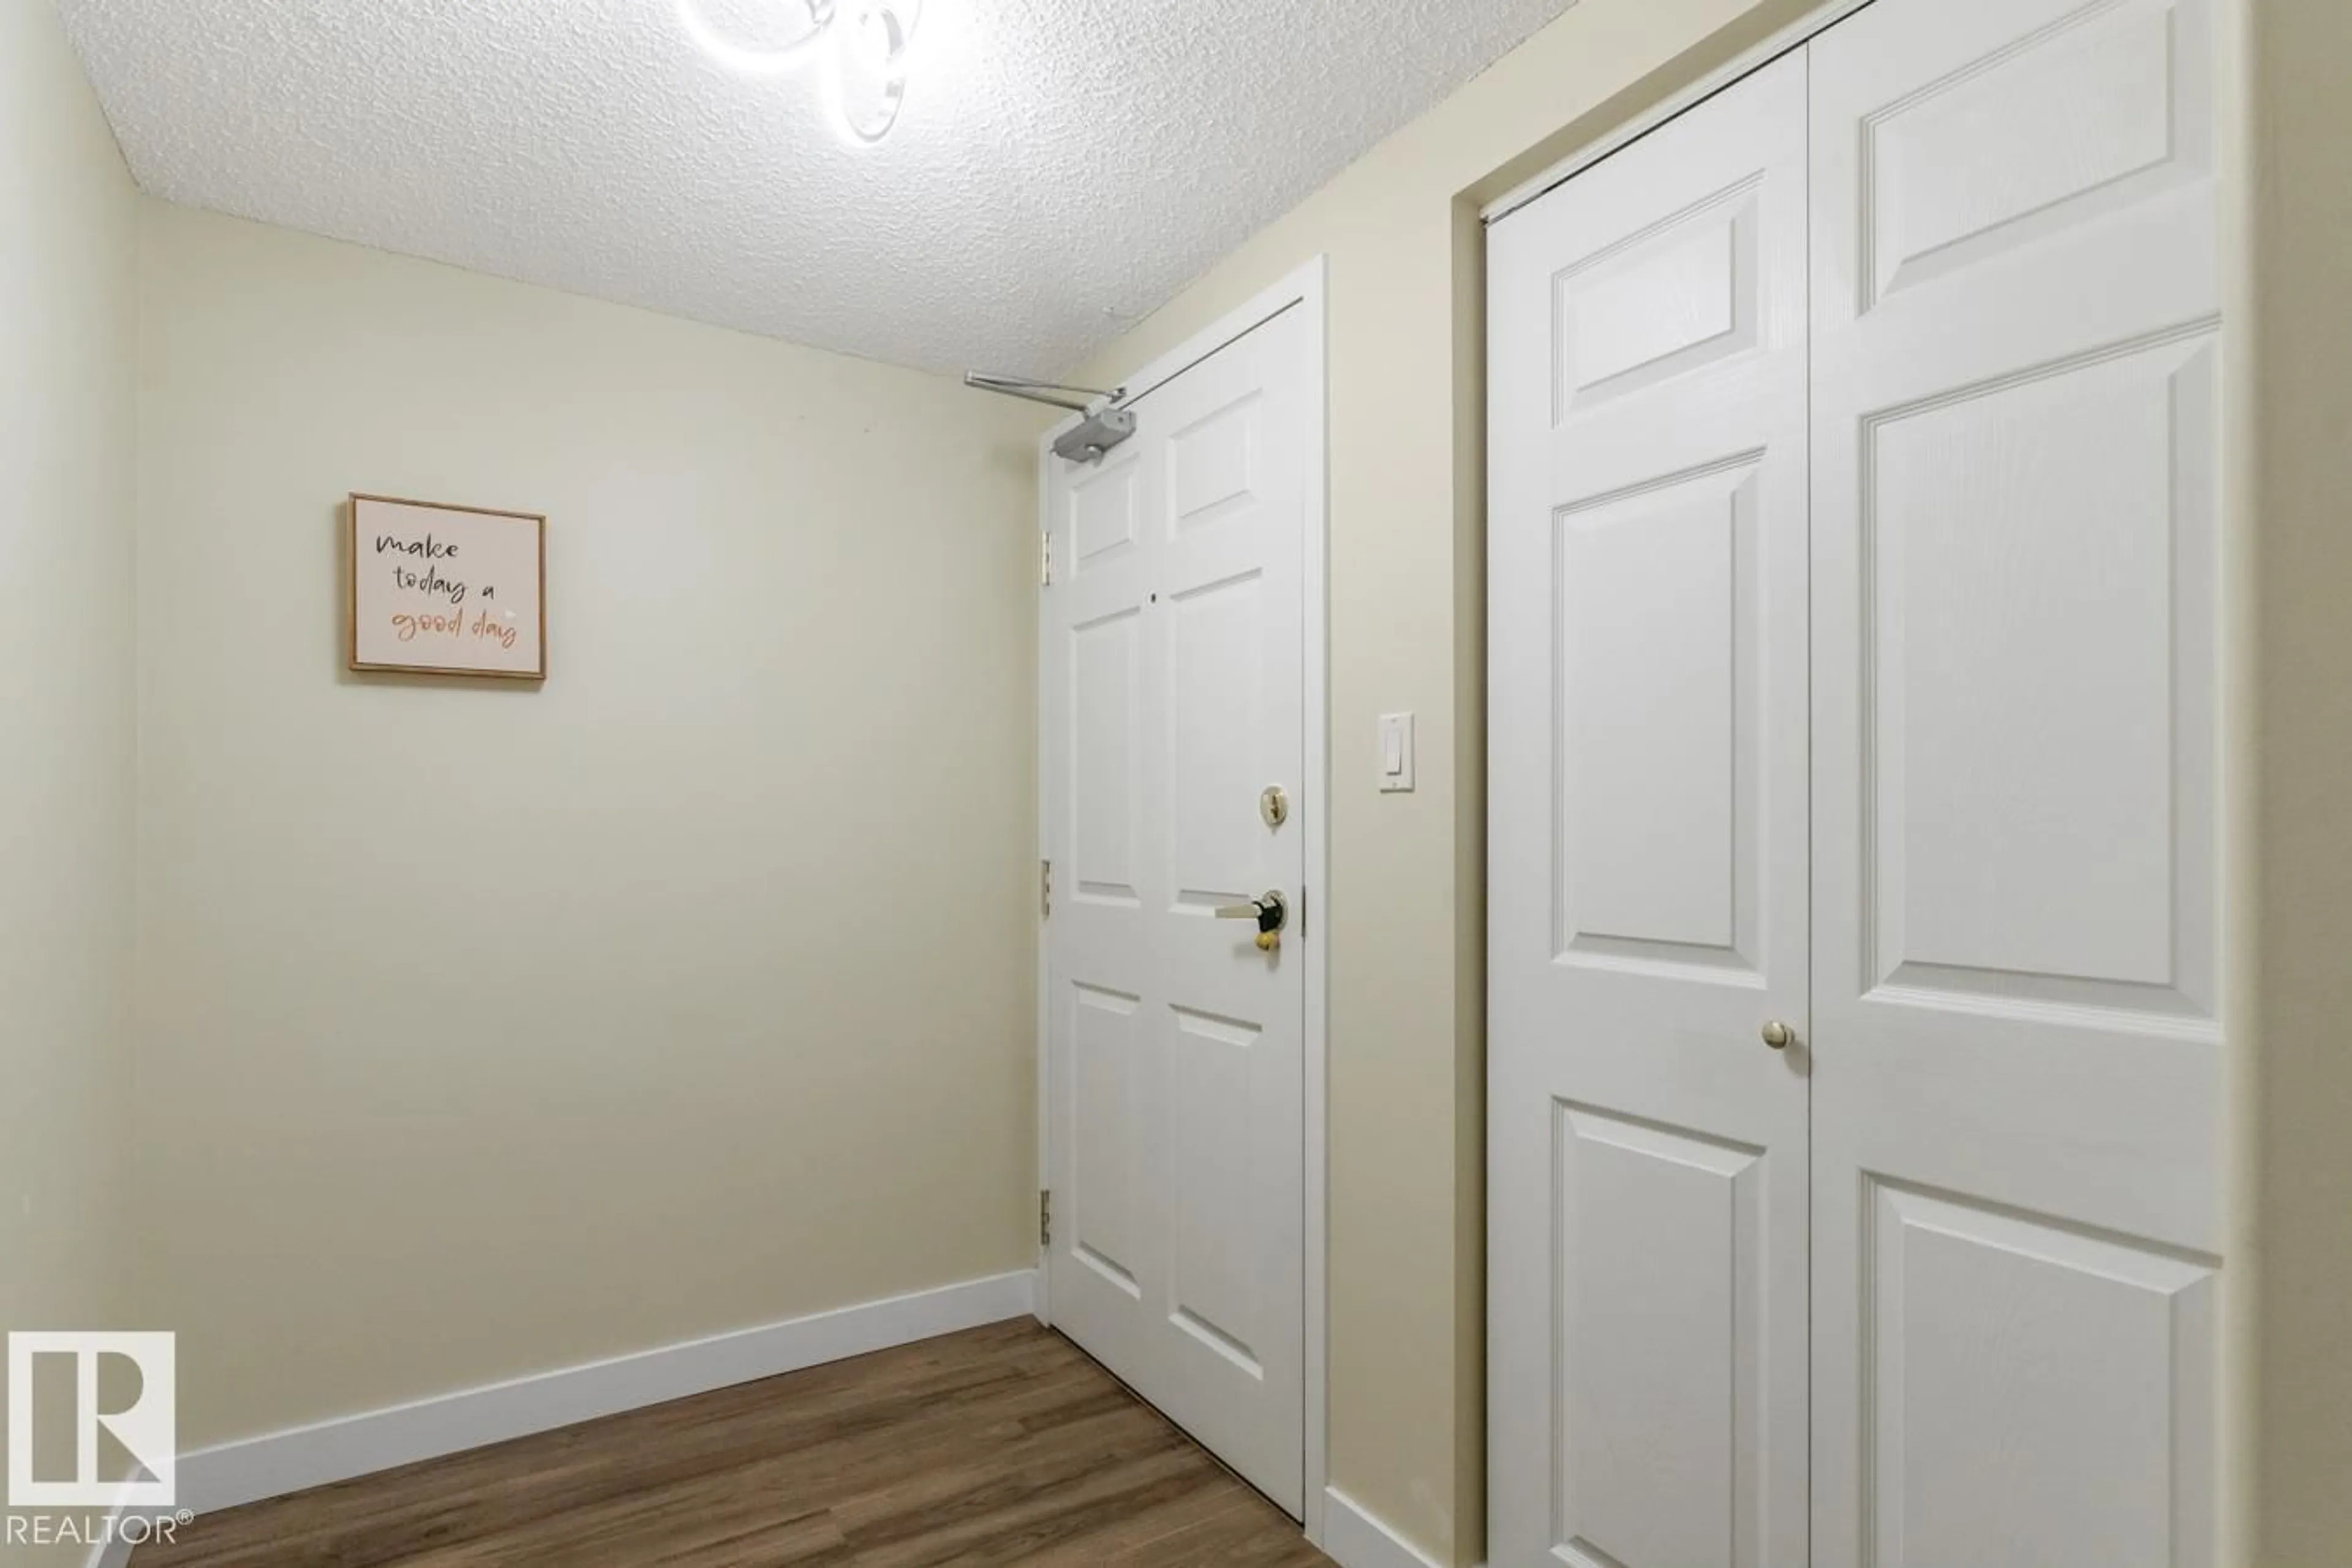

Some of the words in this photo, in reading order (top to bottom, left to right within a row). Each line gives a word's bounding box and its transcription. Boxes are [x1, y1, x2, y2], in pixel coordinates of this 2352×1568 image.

[376, 532, 459, 559] make
[393, 565, 467, 604] today
[482, 585, 495, 600] a
[391, 606, 462, 642] good
[472, 608, 517, 649] day
